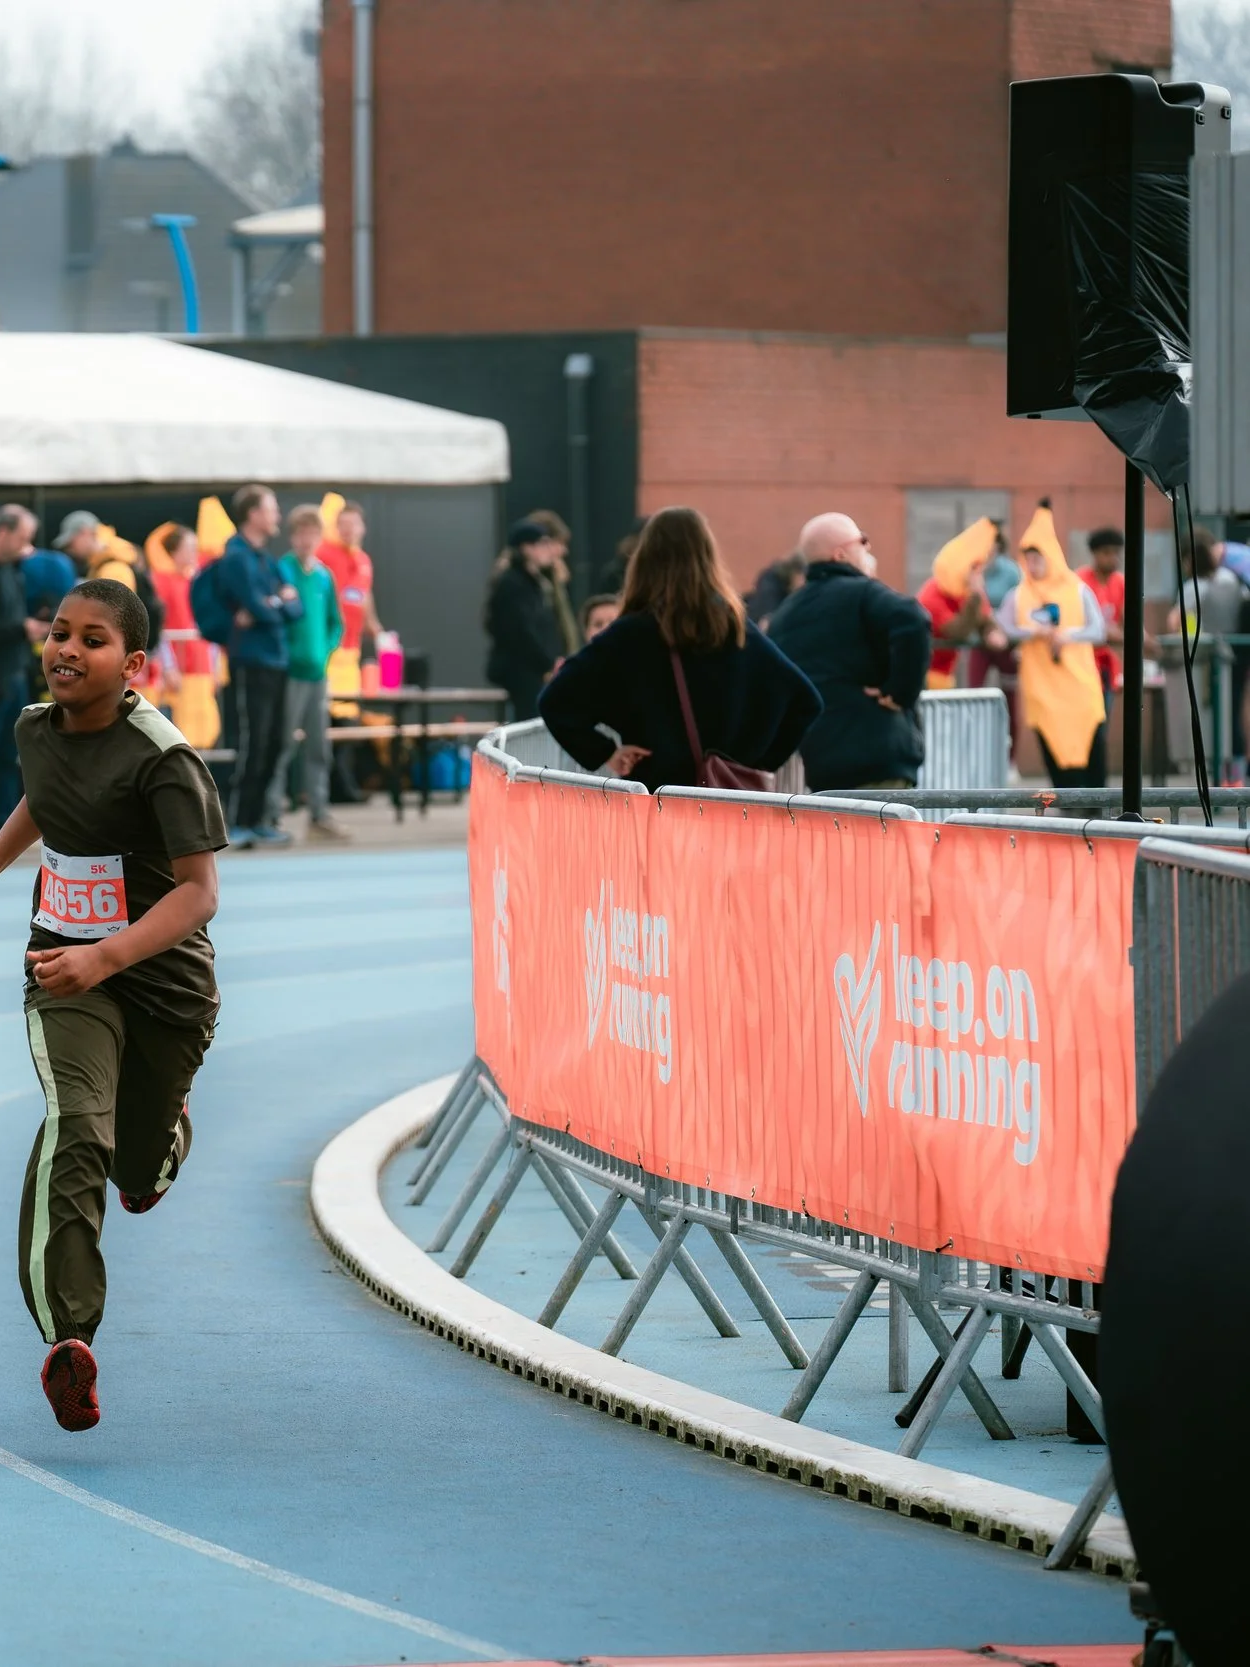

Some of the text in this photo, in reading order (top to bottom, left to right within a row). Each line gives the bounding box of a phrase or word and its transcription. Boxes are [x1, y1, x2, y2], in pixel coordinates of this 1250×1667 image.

[43, 873, 119, 920] 4656
[90, 864, 108, 874] 5K
[892, 922, 1039, 1047] keep.on
[887, 1040, 1041, 1167] running
